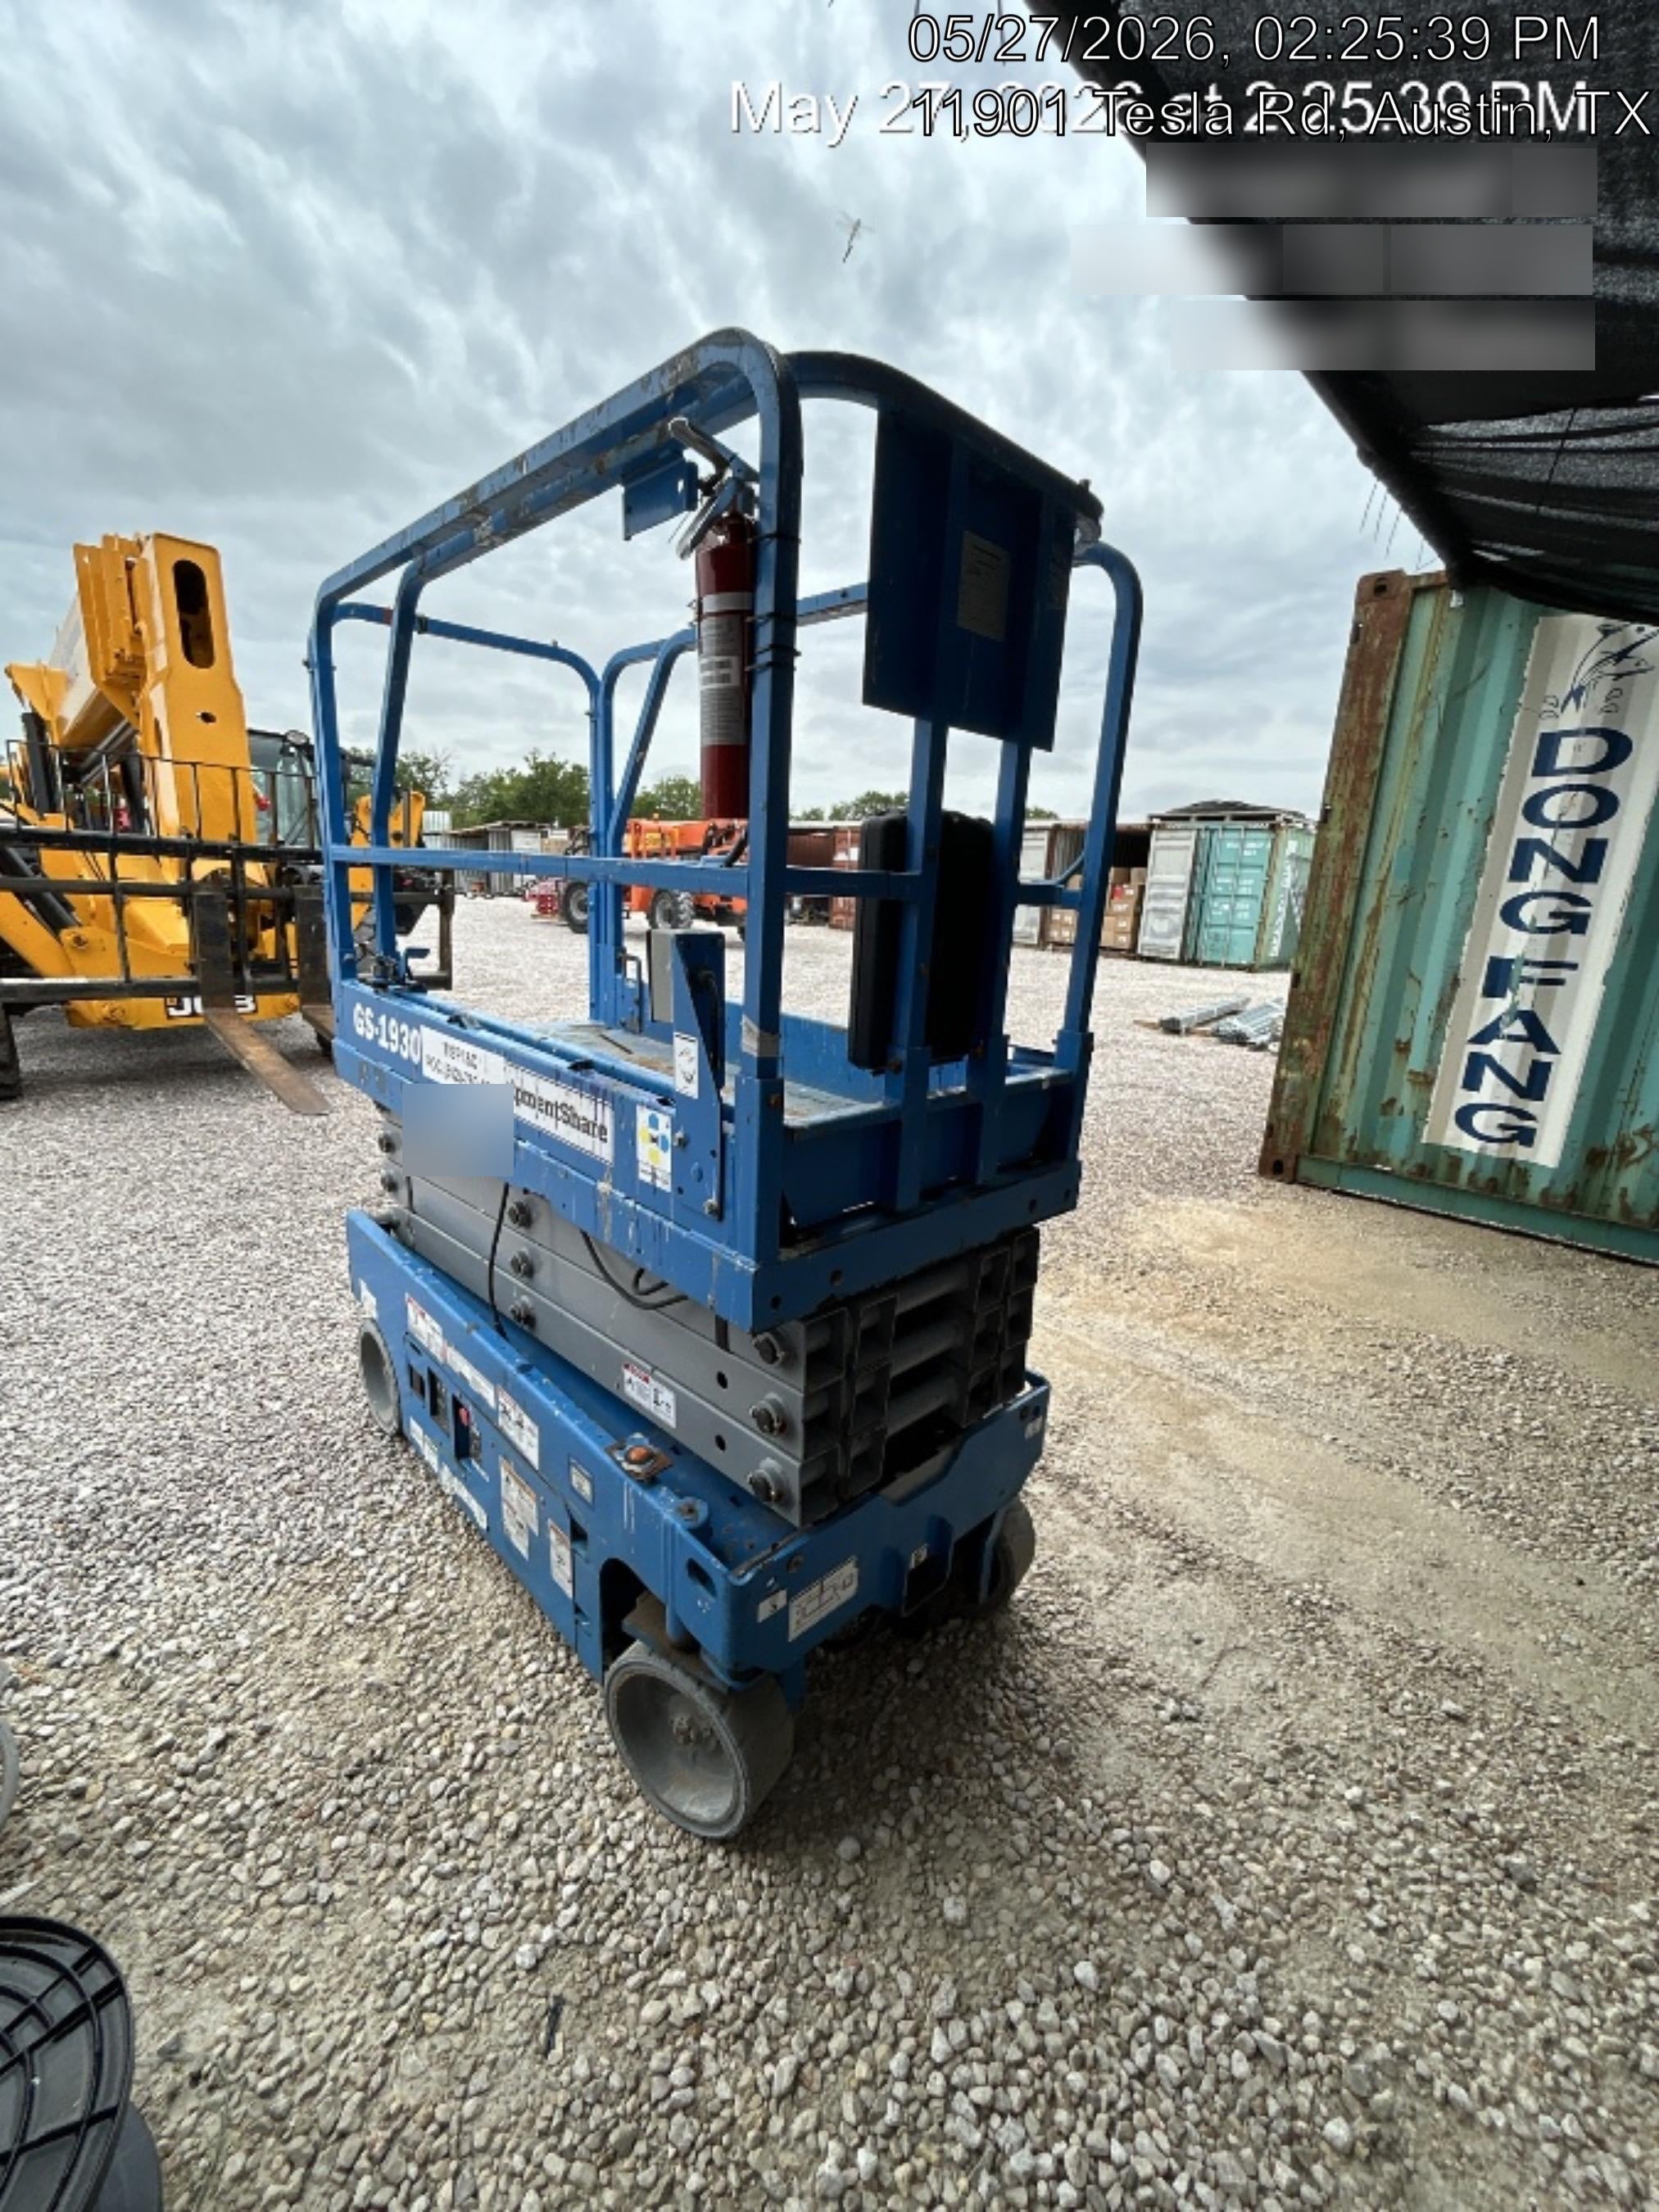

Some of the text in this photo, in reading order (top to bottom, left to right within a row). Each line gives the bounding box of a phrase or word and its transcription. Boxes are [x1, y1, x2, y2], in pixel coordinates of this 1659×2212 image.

[1498, 727, 1634, 936] DONG
[352, 1001, 422, 1066] GS-1930
[1454, 954, 1580, 1149] FANG
